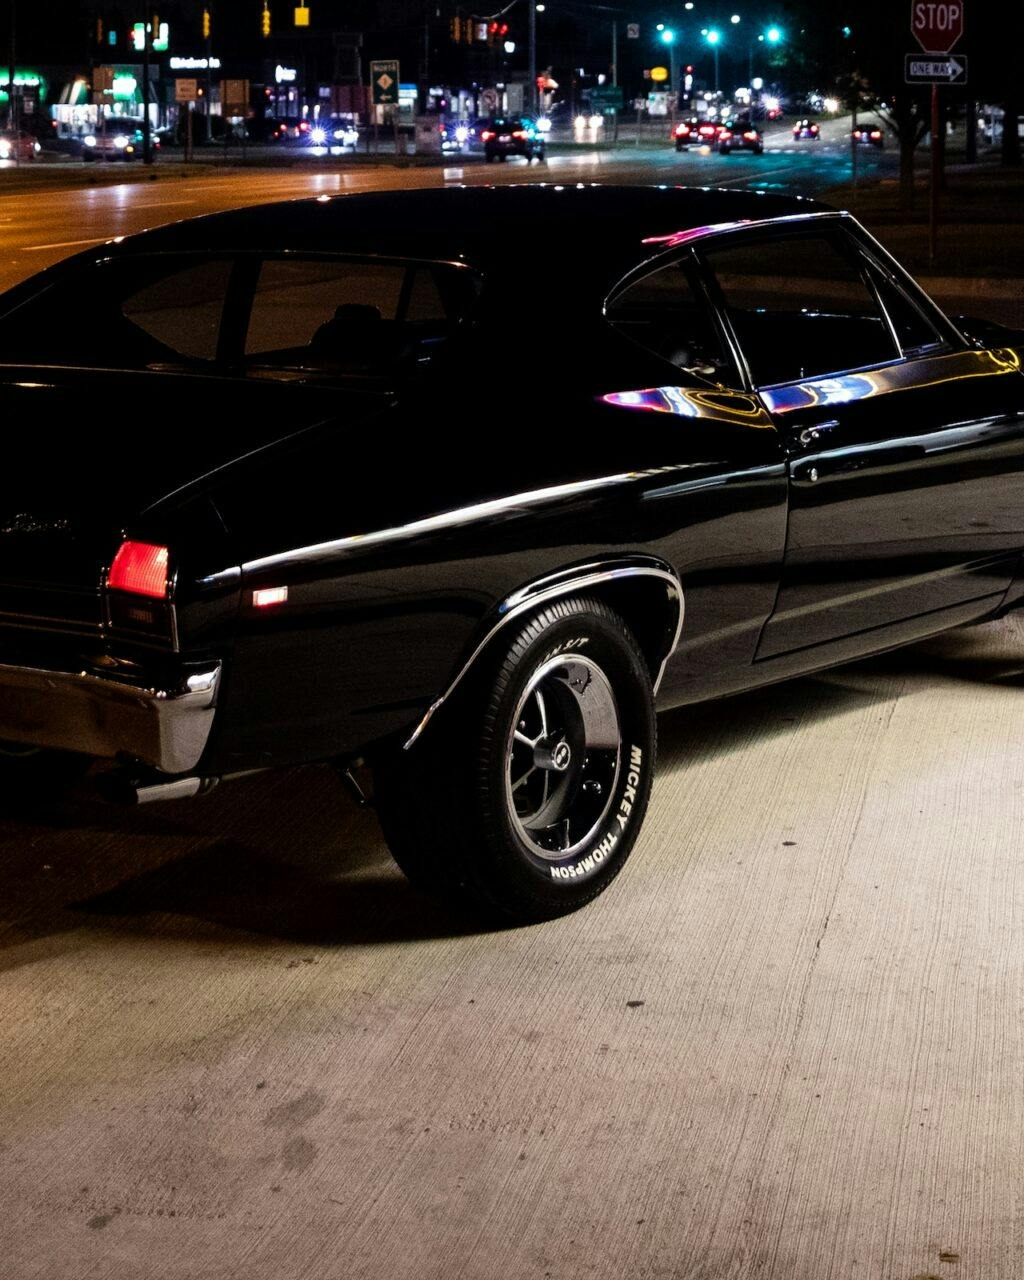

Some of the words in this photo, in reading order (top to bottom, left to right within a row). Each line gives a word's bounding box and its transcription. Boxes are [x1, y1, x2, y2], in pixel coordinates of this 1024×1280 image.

[915, 3, 960, 30] STOP
[911, 62, 930, 74] ONE
[932, 62, 949, 75] WAY
[620, 744, 643, 831] MICKEY
[550, 832, 618, 880] THOMPSON
